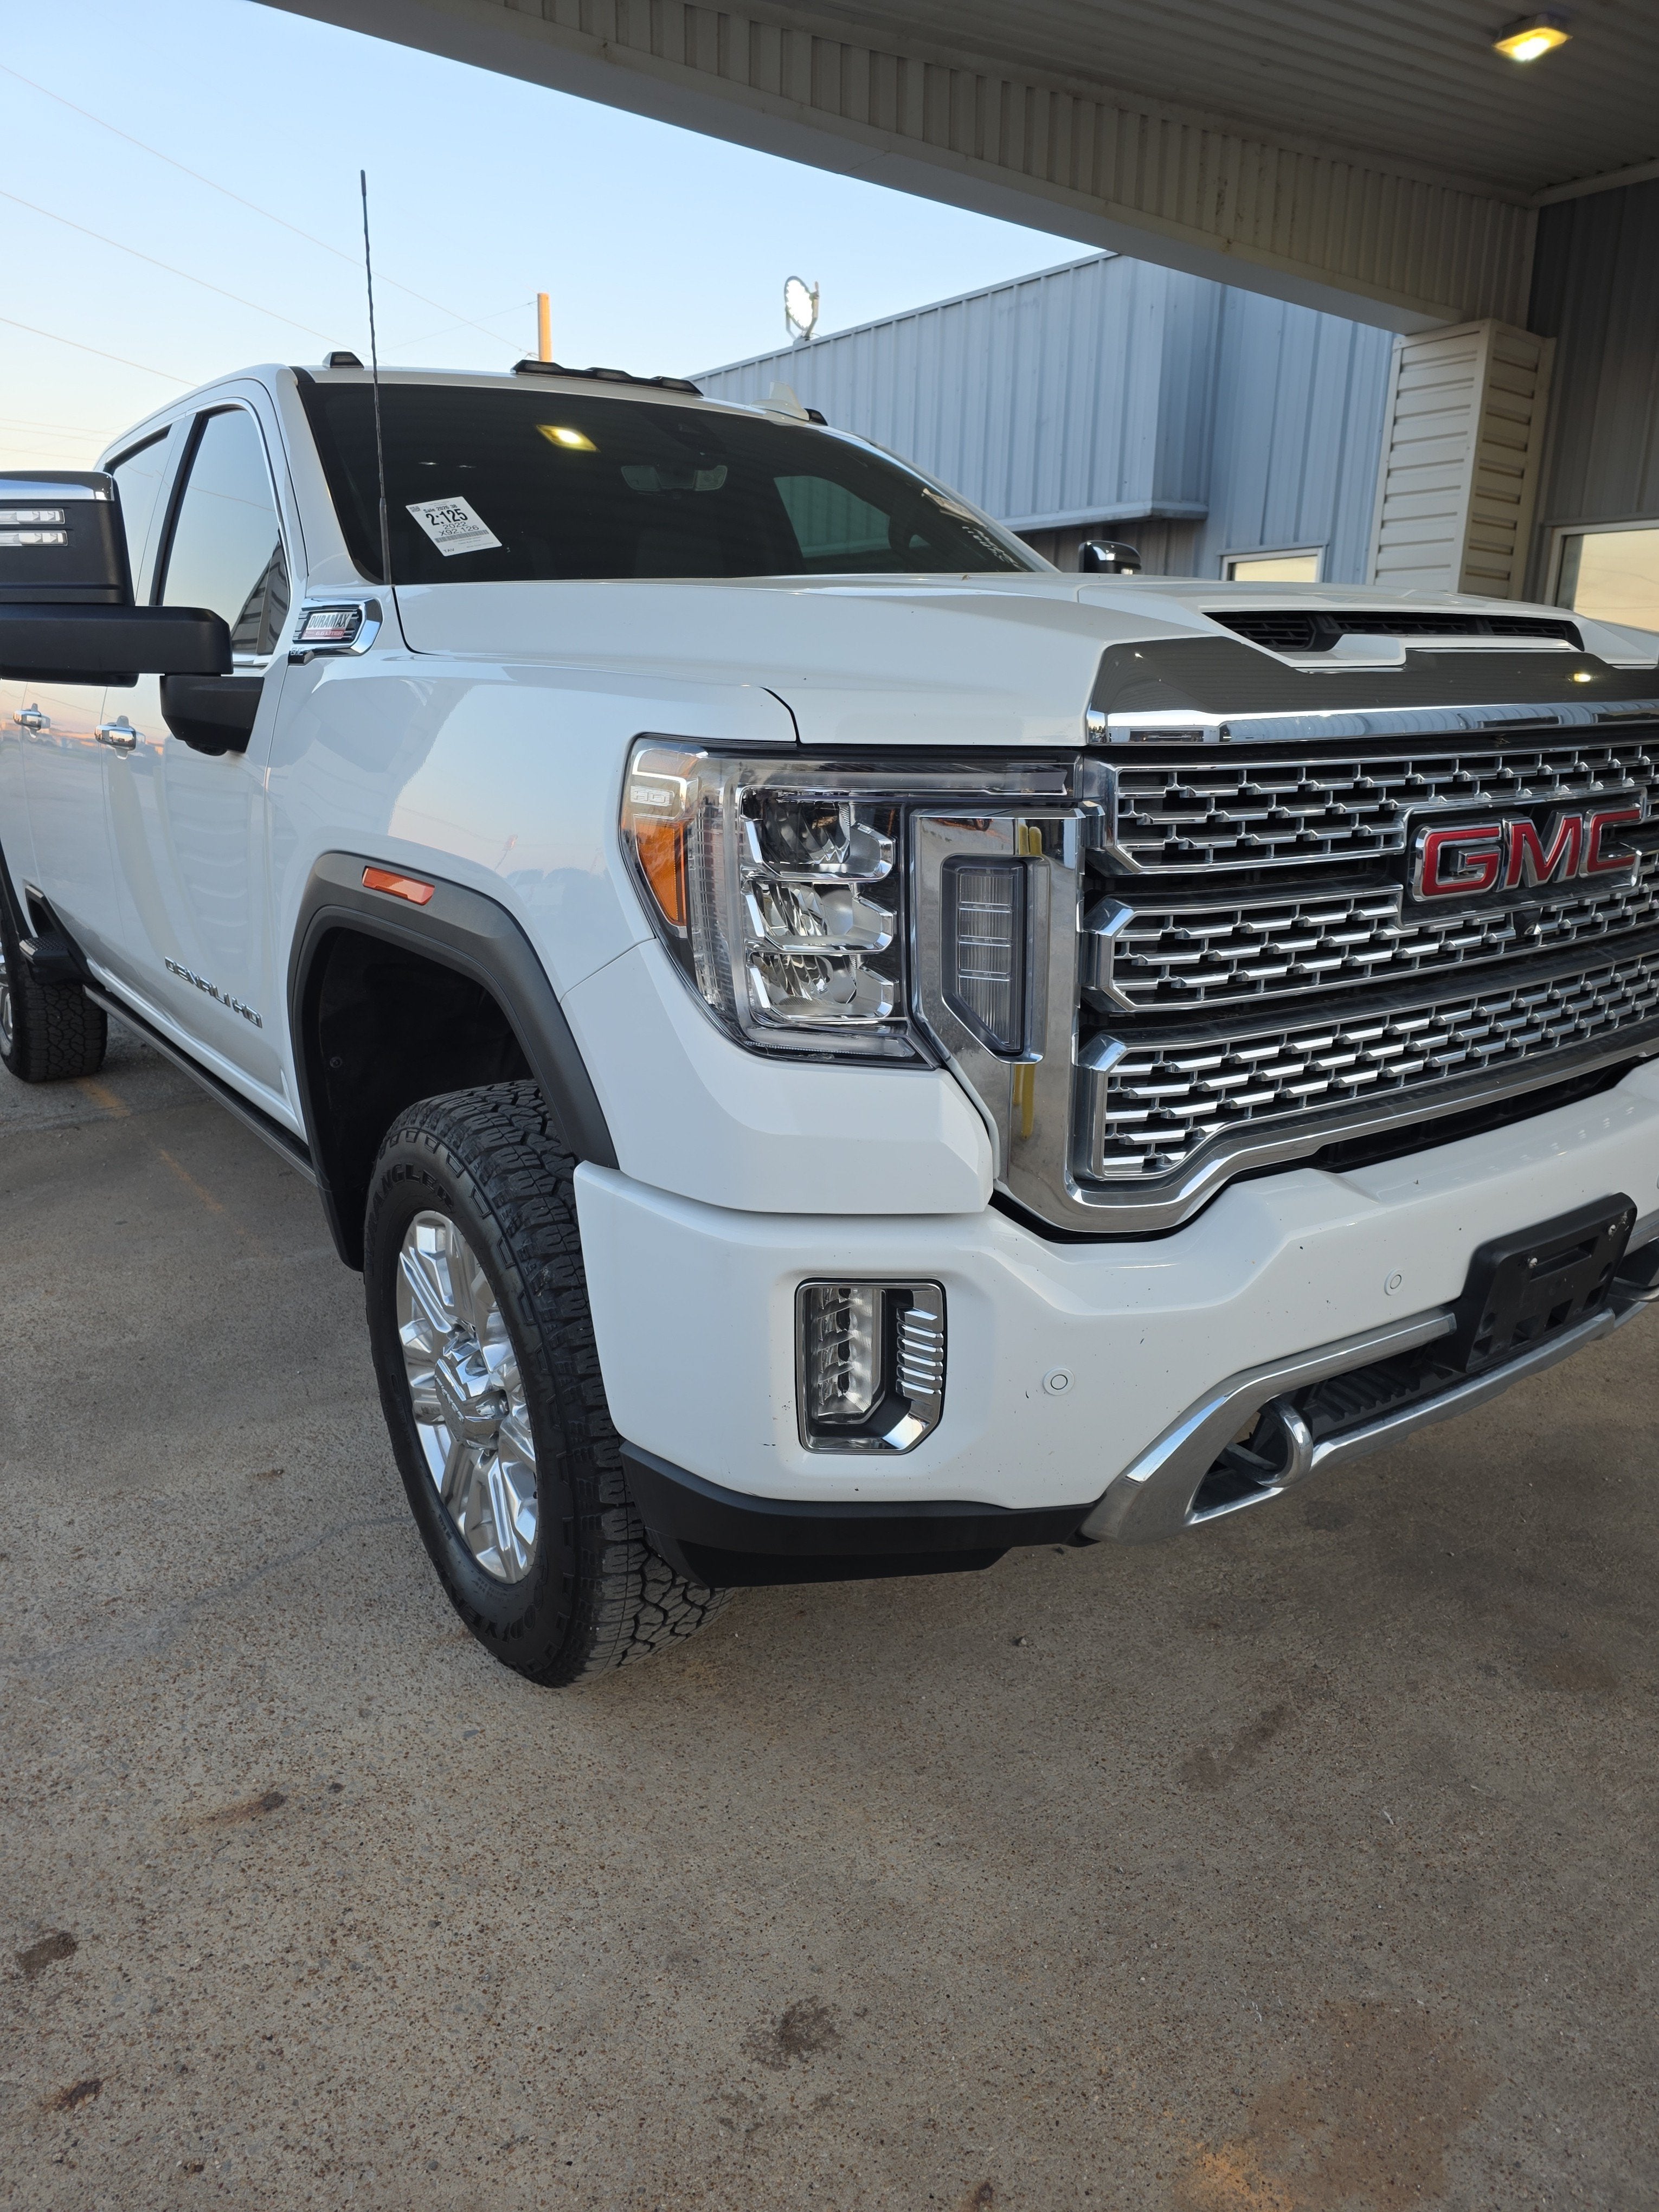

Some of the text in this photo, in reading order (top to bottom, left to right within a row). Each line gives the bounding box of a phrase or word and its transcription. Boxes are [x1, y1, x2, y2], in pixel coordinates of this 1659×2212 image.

[426, 508, 468, 526] 2:125
[439, 525, 479, 536] X92,126
[442, 522, 468, 530] 2022
[308, 613, 350, 628] DURAMAX
[633, 790, 666, 803] HD
[1412, 808, 1642, 902] GMC
[164, 956, 231, 1008] DENALI
